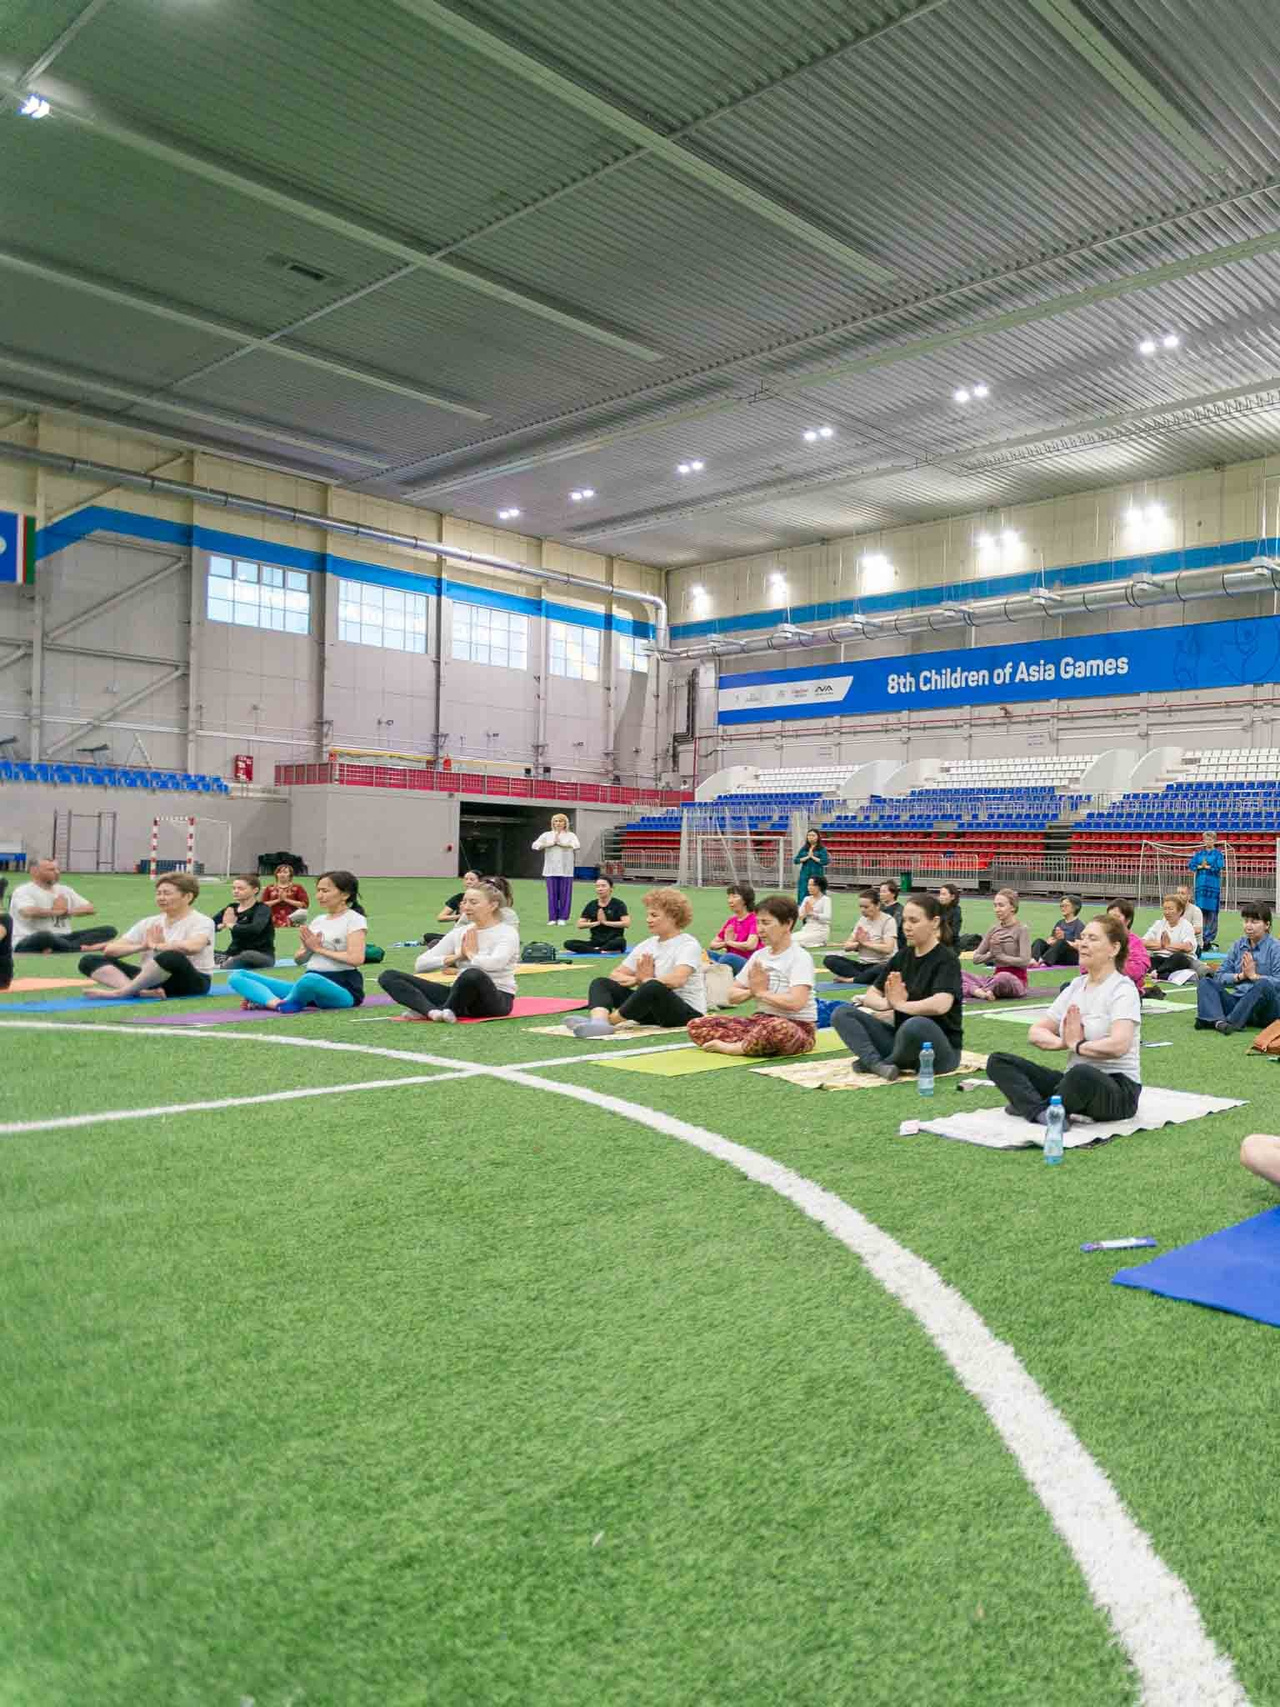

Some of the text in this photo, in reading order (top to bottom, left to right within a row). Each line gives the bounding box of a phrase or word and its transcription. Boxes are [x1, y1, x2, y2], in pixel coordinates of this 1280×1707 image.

[887, 656, 1129, 694] 8th Children of Asia Games
